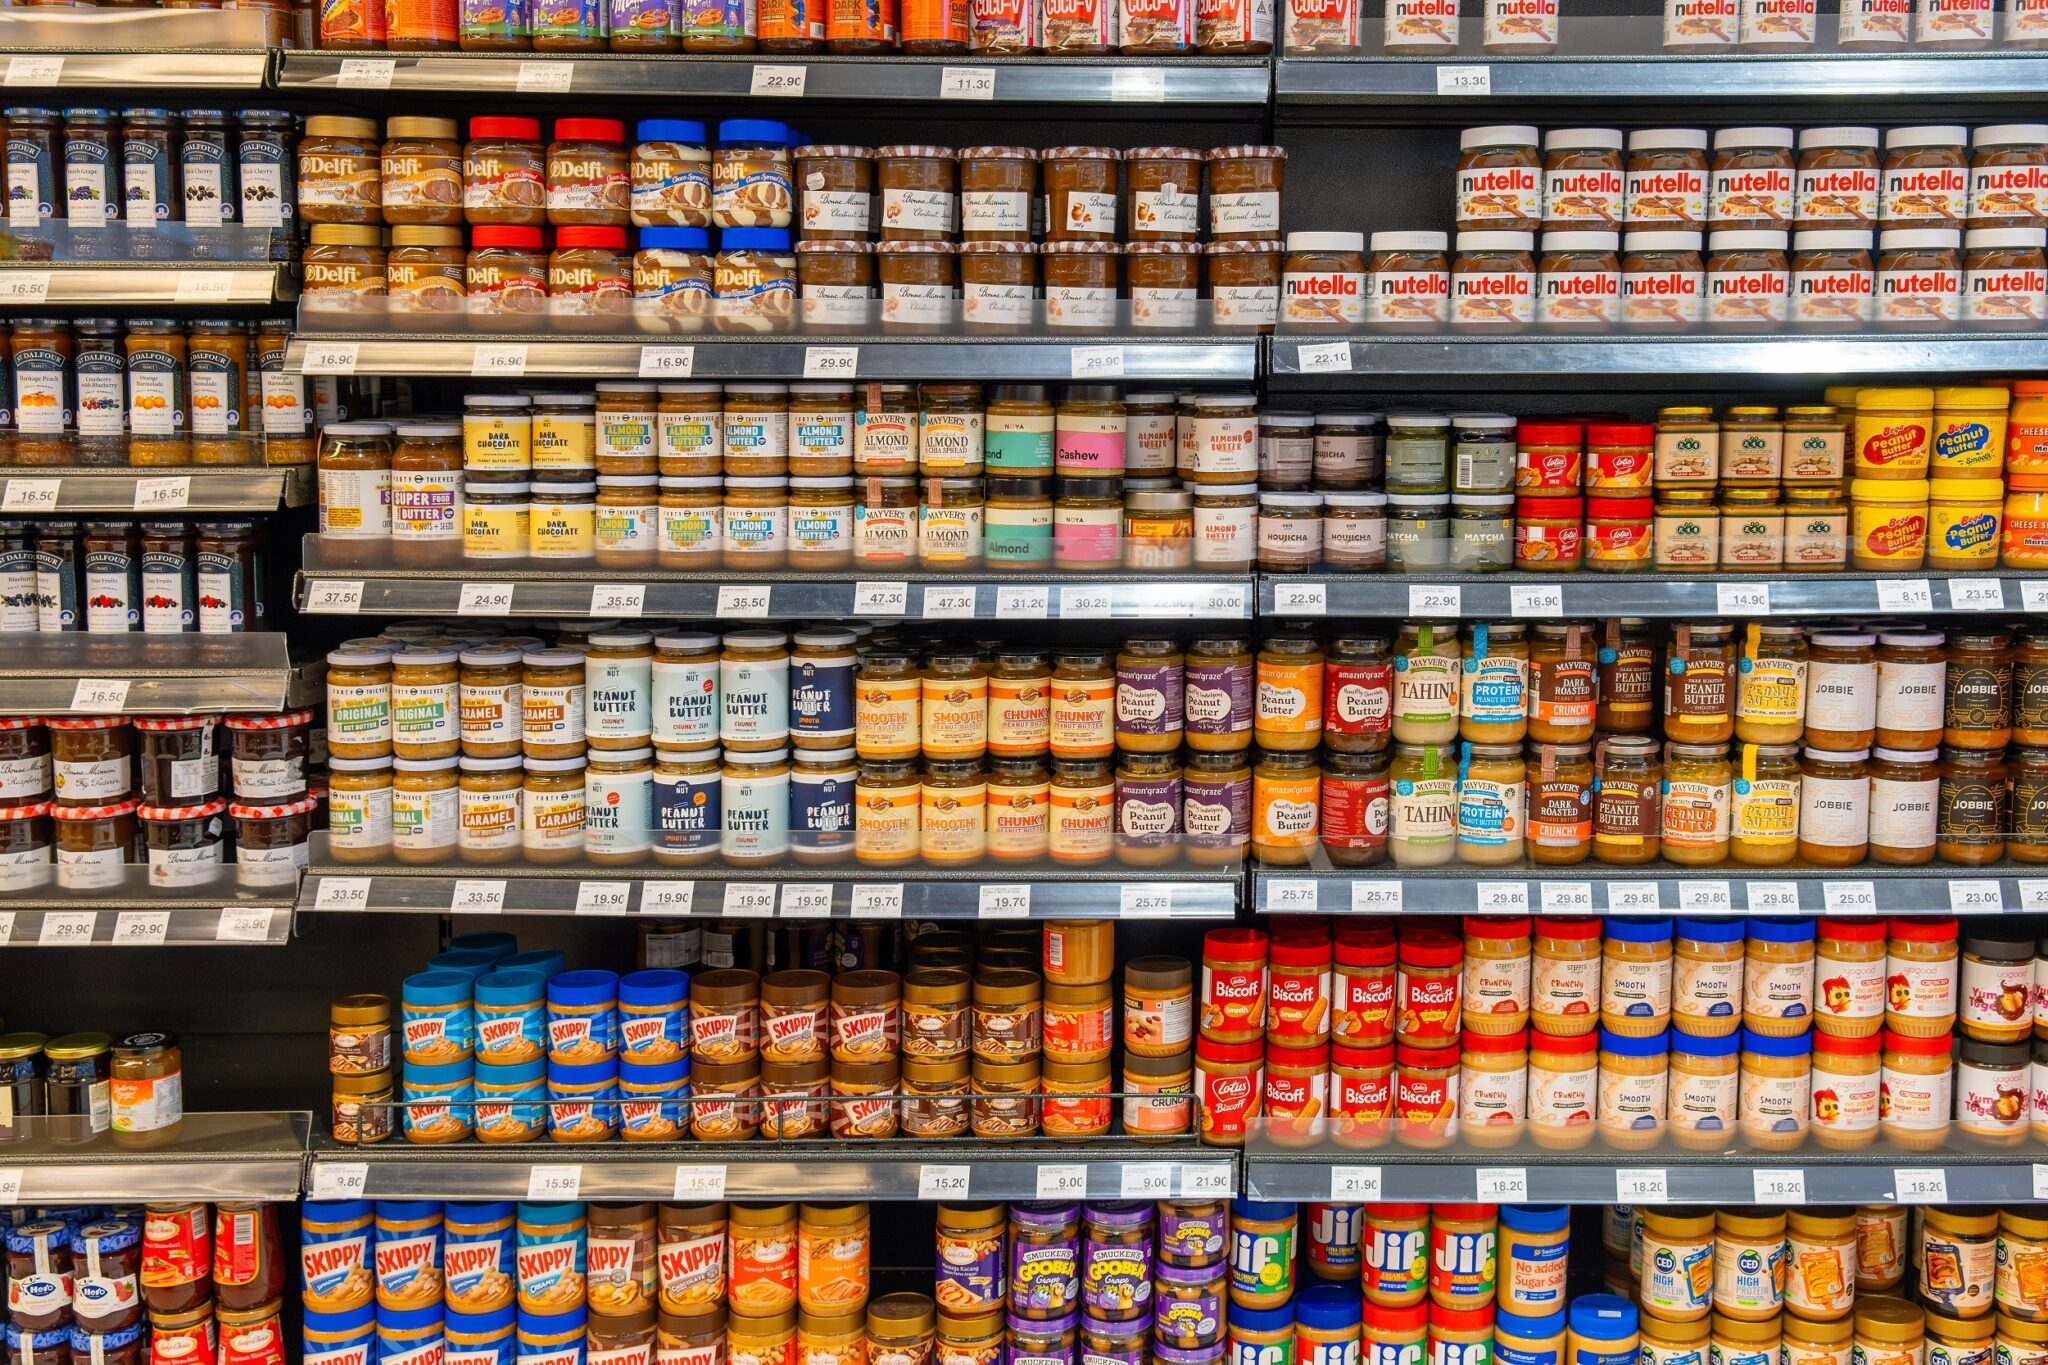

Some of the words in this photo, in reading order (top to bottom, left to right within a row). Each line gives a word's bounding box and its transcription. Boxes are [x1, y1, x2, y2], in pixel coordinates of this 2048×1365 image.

[767, 76, 801, 86] 22.90
[957, 80, 990, 90] 11.30
[1454, 77, 1485, 85] 13.30
[242, 144, 278, 158] DALFOUR
[312, 157, 353, 175] Delfi
[560, 162, 601, 178] Delfi
[1463, 172, 1533, 192] nutella
[1553, 172, 1620, 193] nutella
[1718, 171, 1789, 192] nutella
[722, 270, 761, 286] Delfi
[1801, 273, 1870, 293] nutella
[11, 284, 44, 294] 16.50
[1288, 276, 1356, 295] nutella
[23, 351, 62, 364] DALFOUR
[320, 355, 352, 365] 16.90
[490, 356, 522, 365] 16.90
[657, 358, 688, 367] 16.90
[820, 357, 852, 368] 29.90
[1087, 356, 1119, 367] 29.90
[1315, 353, 1347, 363] 22.10
[867, 415, 905, 424] MAYVER'S
[607, 426, 644, 434] ALMOND
[802, 427, 837, 435] ALMOND
[926, 437, 968, 446] ALMOND
[1872, 431, 1917, 450] Peanut
[1212, 443, 1241, 451] BUTTER
[1881, 444, 1911, 458] Butter
[1059, 449, 1099, 460] Cashew
[21, 490, 54, 501] 16.50
[152, 488, 184, 499] 16.50
[395, 493, 429, 505] SUPER
[402, 509, 439, 519] BUTTER
[1464, 533, 1504, 541] MATCHA
[90, 555, 126, 566] DALFOUR
[325, 593, 357, 602] 37.50
[870, 594, 902, 603] 47.30
[1290, 595, 1322, 603] 22.90
[1902, 592, 1927, 601] 8.15
[1966, 589, 1999, 599] 23.50
[475, 595, 507, 605] 24.90
[607, 597, 639, 606] 35.50
[733, 598, 765, 607] 35.50
[939, 599, 971, 608] 47.30
[1012, 599, 1044, 608] 31.20
[1075, 599, 1107, 608] 30.25
[1209, 598, 1240, 607] 30.00
[1424, 596, 1456, 606] 22.90
[1527, 597, 1558, 606] 16.90
[1733, 596, 1765, 605] 14.90
[1563, 678, 1584, 687] DARK
[1401, 682, 1455, 699] TAHINI
[1476, 686, 1521, 695] PROTEIN
[1555, 686, 1590, 694] ROASTED
[1684, 684, 1725, 694] PEANUT
[1816, 685, 1854, 695] JOBBIE
[1957, 684, 1997, 695] JOBBIE
[90, 691, 122, 701] 16.50
[593, 690, 636, 700] PEANUT
[1684, 694, 1725, 704] BUTTER
[1346, 697, 1383, 705] Peanut
[593, 702, 636, 712] BUTTER
[1348, 706, 1382, 715] Butter
[1553, 703, 1589, 716] CRUNCHY
[337, 706, 384, 720] ORIGINAL
[858, 712, 906, 722] SMOOTH
[1056, 711, 1104, 721] CHUNKY
[466, 811, 511, 826] CARAMEL
[332, 890, 364, 900] 33.50
[468, 893, 500, 902] 33.50
[593, 894, 624, 904] 19.90
[657, 893, 688, 902] 19.90
[1282, 890, 1313, 900] 25.75
[1367, 892, 1398, 901] 25.75
[1493, 894, 1524, 903] 29.80
[1556, 894, 1587, 904] 29.80
[1624, 894, 1654, 903] 29.80
[1695, 893, 1726, 903] 29.80
[1763, 894, 1794, 904] 29.80
[1840, 894, 1872, 904] 25.00
[1966, 892, 1998, 902] 23.00
[740, 896, 770, 906] 19.90
[796, 896, 827, 906] 19.90
[867, 897, 898, 907] 19.70
[994, 897, 1025, 907] 19.70
[1136, 898, 1167, 907] 25.75
[234, 919, 266, 928] 29.90
[57, 924, 89, 934] 29.90
[130, 924, 163, 934] 29.90
[1216, 980, 1257, 997] Biscoff
[1480, 979, 1512, 988] CRUNCHY
[1615, 980, 1645, 989] SMOOTH
[1972, 988, 1997, 999] Yum
[407, 1021, 444, 1042] SKIPPY
[773, 1016, 813, 1039] SKIPPY
[337, 1177, 361, 1187] 9.80
[545, 1179, 576, 1188] 15.95
[690, 1178, 721, 1188] 15.40
[935, 1178, 965, 1188] 15.20
[1058, 1178, 1082, 1187] 9.00
[1144, 1178, 1167, 1187] 9.00
[1196, 1177, 1227, 1186] 21.90
[1347, 1180, 1376, 1189] 21.90
[1492, 1181, 1523, 1191] 18.20
[1632, 1182, 1663, 1191] 18.20
[1911, 1182, 1942, 1191] 18.20
[1770, 1183, 1800, 1192] 18.20
[1366, 1230, 1425, 1271] Jif
[305, 1243, 362, 1278] SKIPPY
[661, 1241, 722, 1280] SKIPPY
[1026, 1251, 1073, 1261] SMUCKER'S
[1516, 1263, 1531, 1273] No
[1534, 1261, 1563, 1272] added
[1657, 1258, 1673, 1269] CED
[1018, 1260, 1075, 1282] GOOBER
[1036, 1276, 1060, 1284] Grape
[1515, 1275, 1543, 1288] Sugar
[1547, 1274, 1563, 1285] Salt
[1653, 1274, 1674, 1287] HIGH
[1653, 1284, 1684, 1296] PROTEIN
